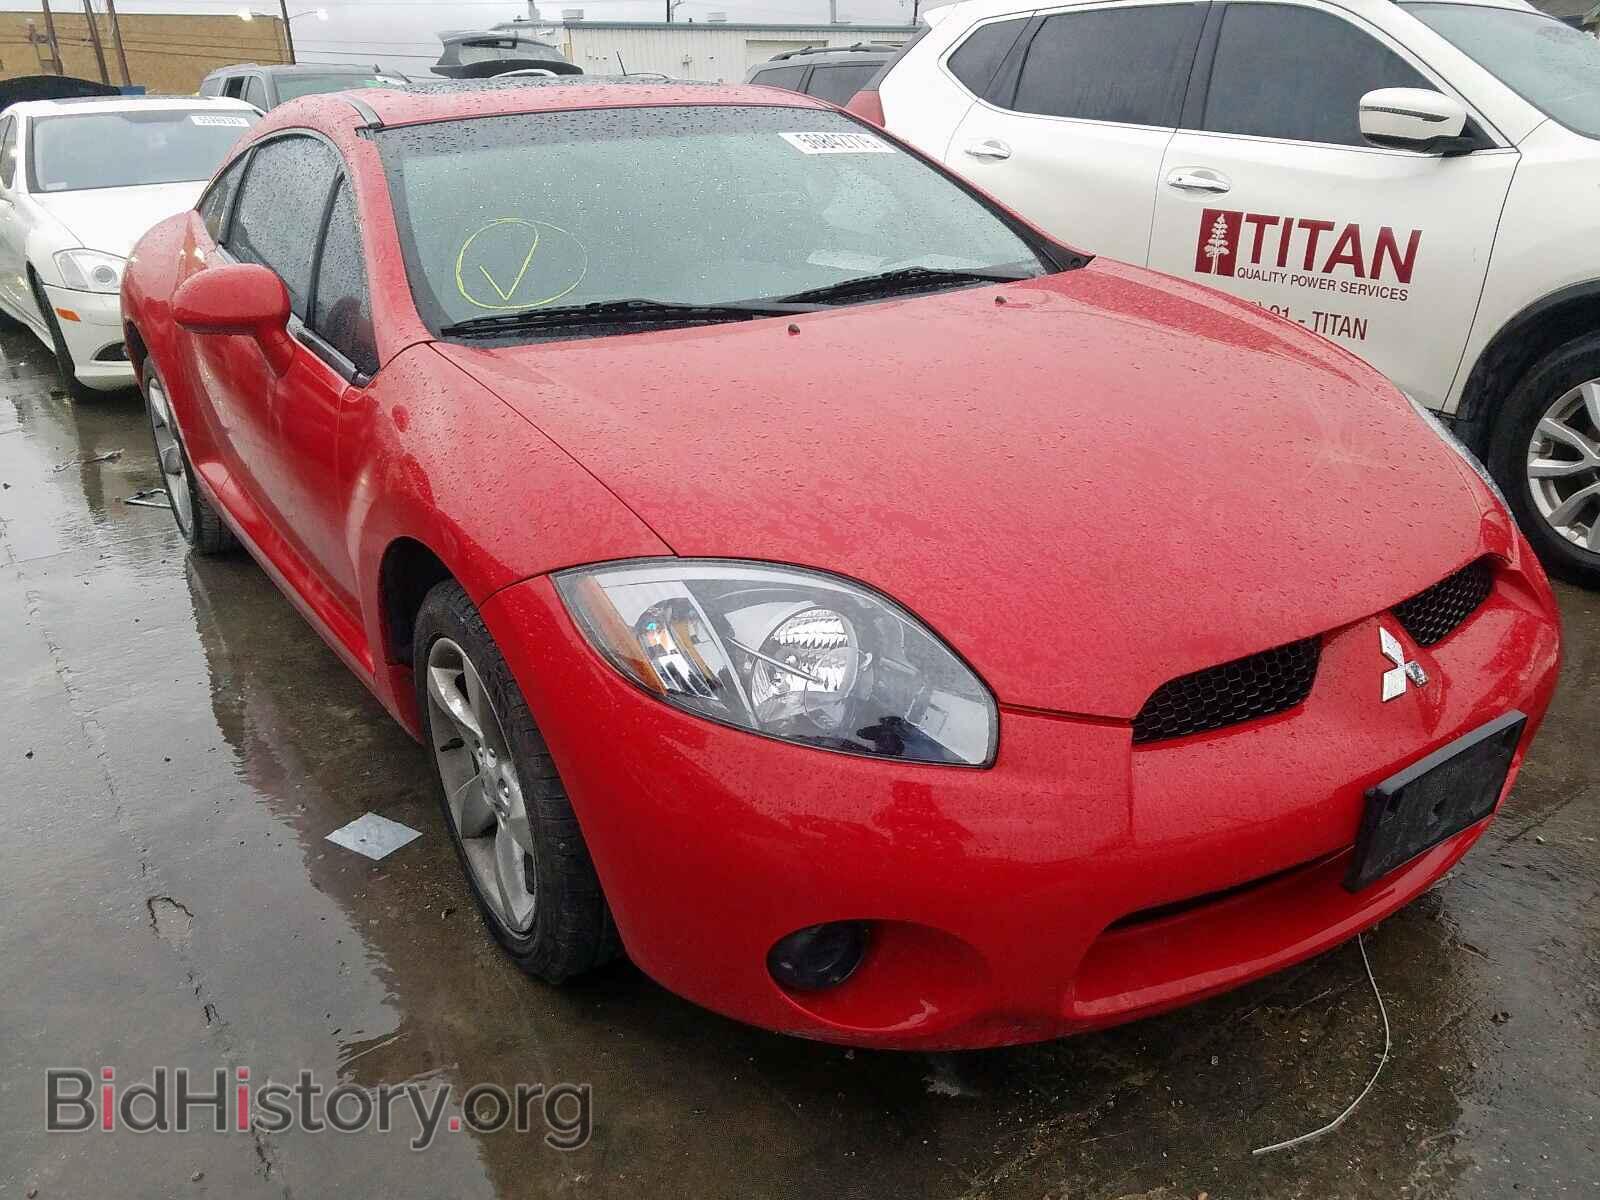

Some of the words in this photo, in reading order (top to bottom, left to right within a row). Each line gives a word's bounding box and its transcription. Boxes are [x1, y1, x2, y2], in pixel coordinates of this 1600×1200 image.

[1244, 213, 1423, 284] TITAN
[1237, 267, 1287, 286] QUALITY
[1291, 275, 1337, 292] POWER
[1340, 281, 1409, 301] SERVICES
[1312, 311, 1368, 341] TITAN
